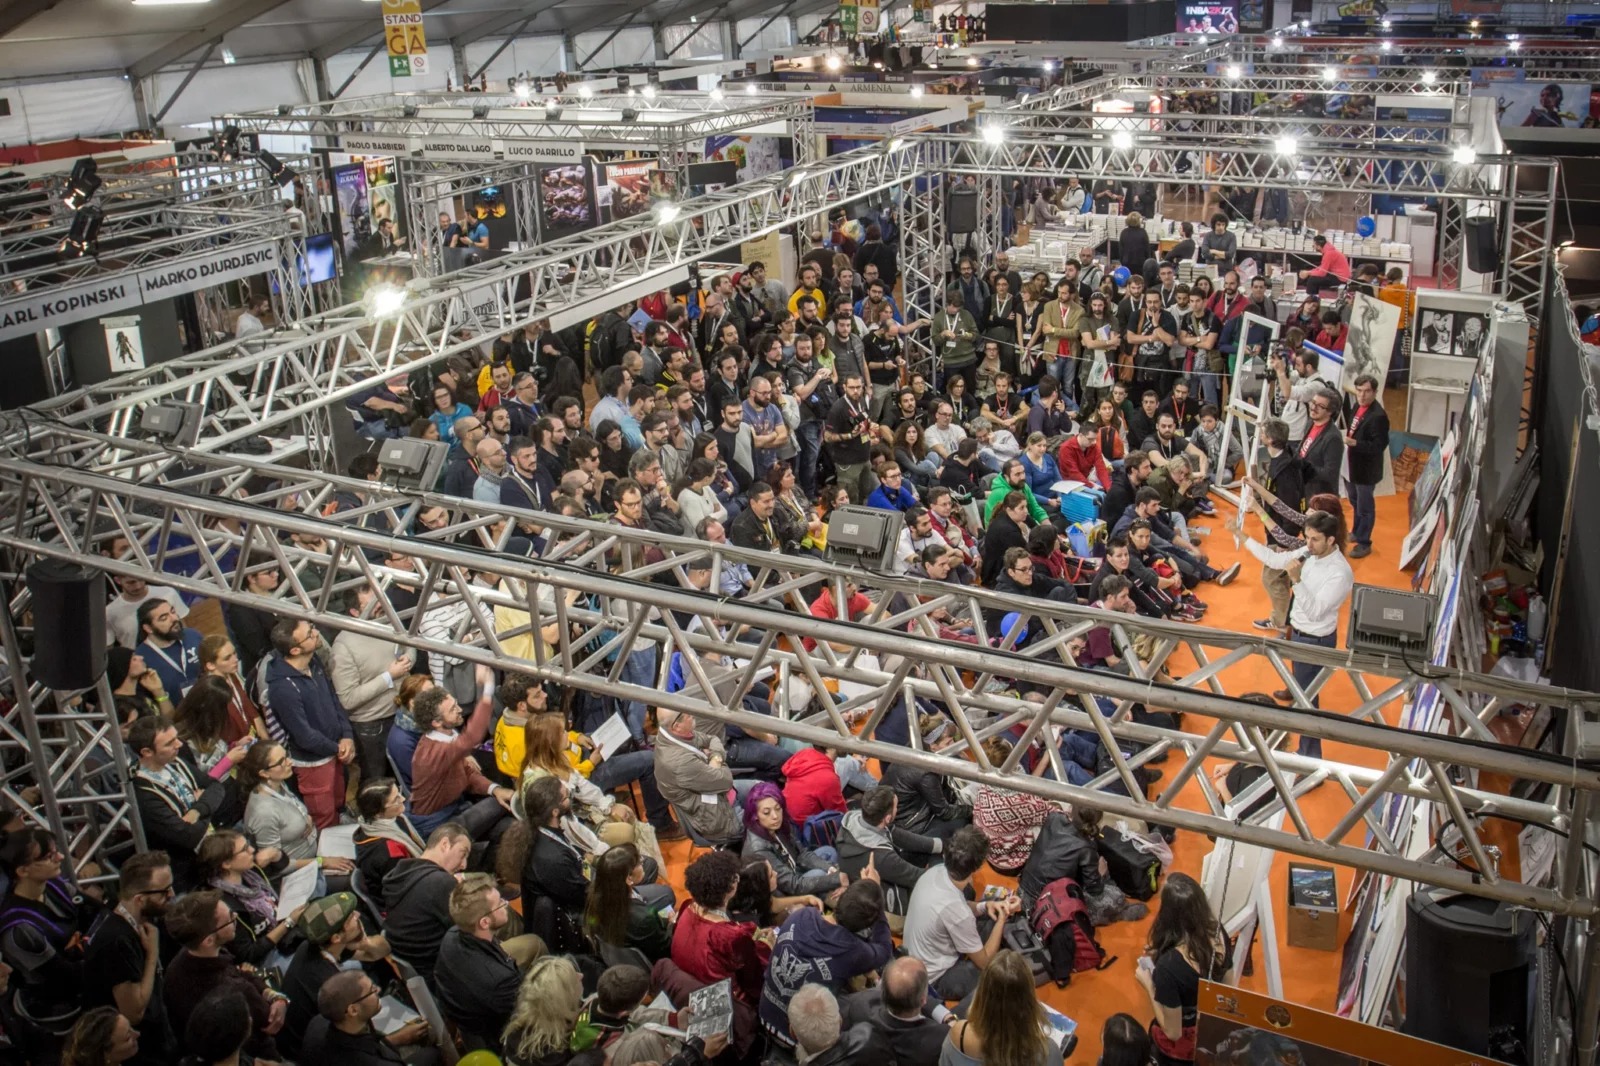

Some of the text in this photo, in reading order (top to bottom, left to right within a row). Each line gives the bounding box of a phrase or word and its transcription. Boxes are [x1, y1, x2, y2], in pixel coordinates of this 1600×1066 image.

[385, 14, 421, 25] STAND
[850, 83, 893, 92] ARMENIA
[346, 141, 406, 152] PAOLO BARBIERI
[424, 143, 491, 153] ALBERTO DAL LAGO
[508, 147, 575, 157] LUCIO PARRILLO
[146, 248, 274, 291] MARKO DJURDJEVIC
[0, 284, 126, 329] ARL KOPINSKI
